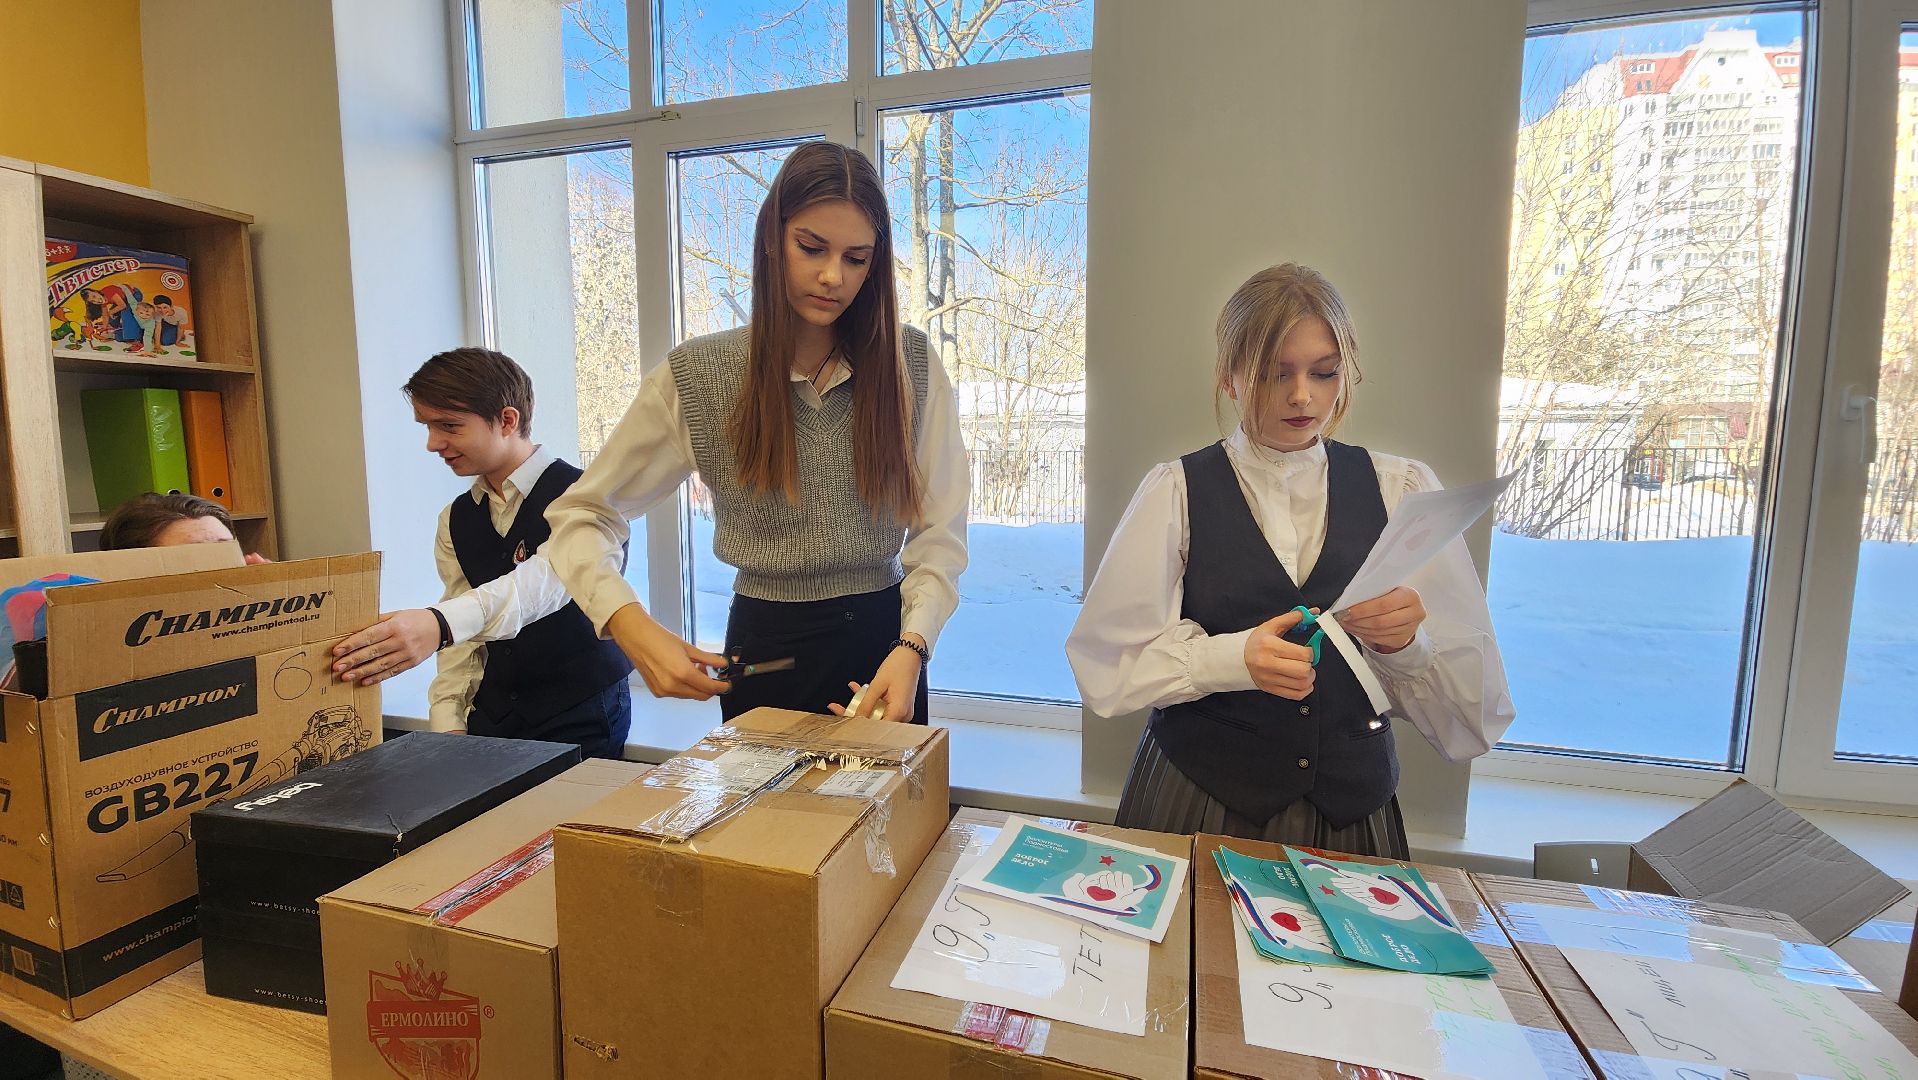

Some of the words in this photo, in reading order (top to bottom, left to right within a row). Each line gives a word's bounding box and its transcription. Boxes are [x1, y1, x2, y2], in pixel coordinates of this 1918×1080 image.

[124, 591, 328, 647] CHAMPION
[211, 612, 320, 640] www.championtool.ru
[93, 683, 241, 734] CHAMPION
[84, 760, 190, 799] ВОЗДУХОДУВНОЕ
[191, 739, 259, 766] УСТРОЙСТВО
[87, 751, 259, 834] GB227
[380, 1010, 469, 1028] ЕРМОЛИНО
